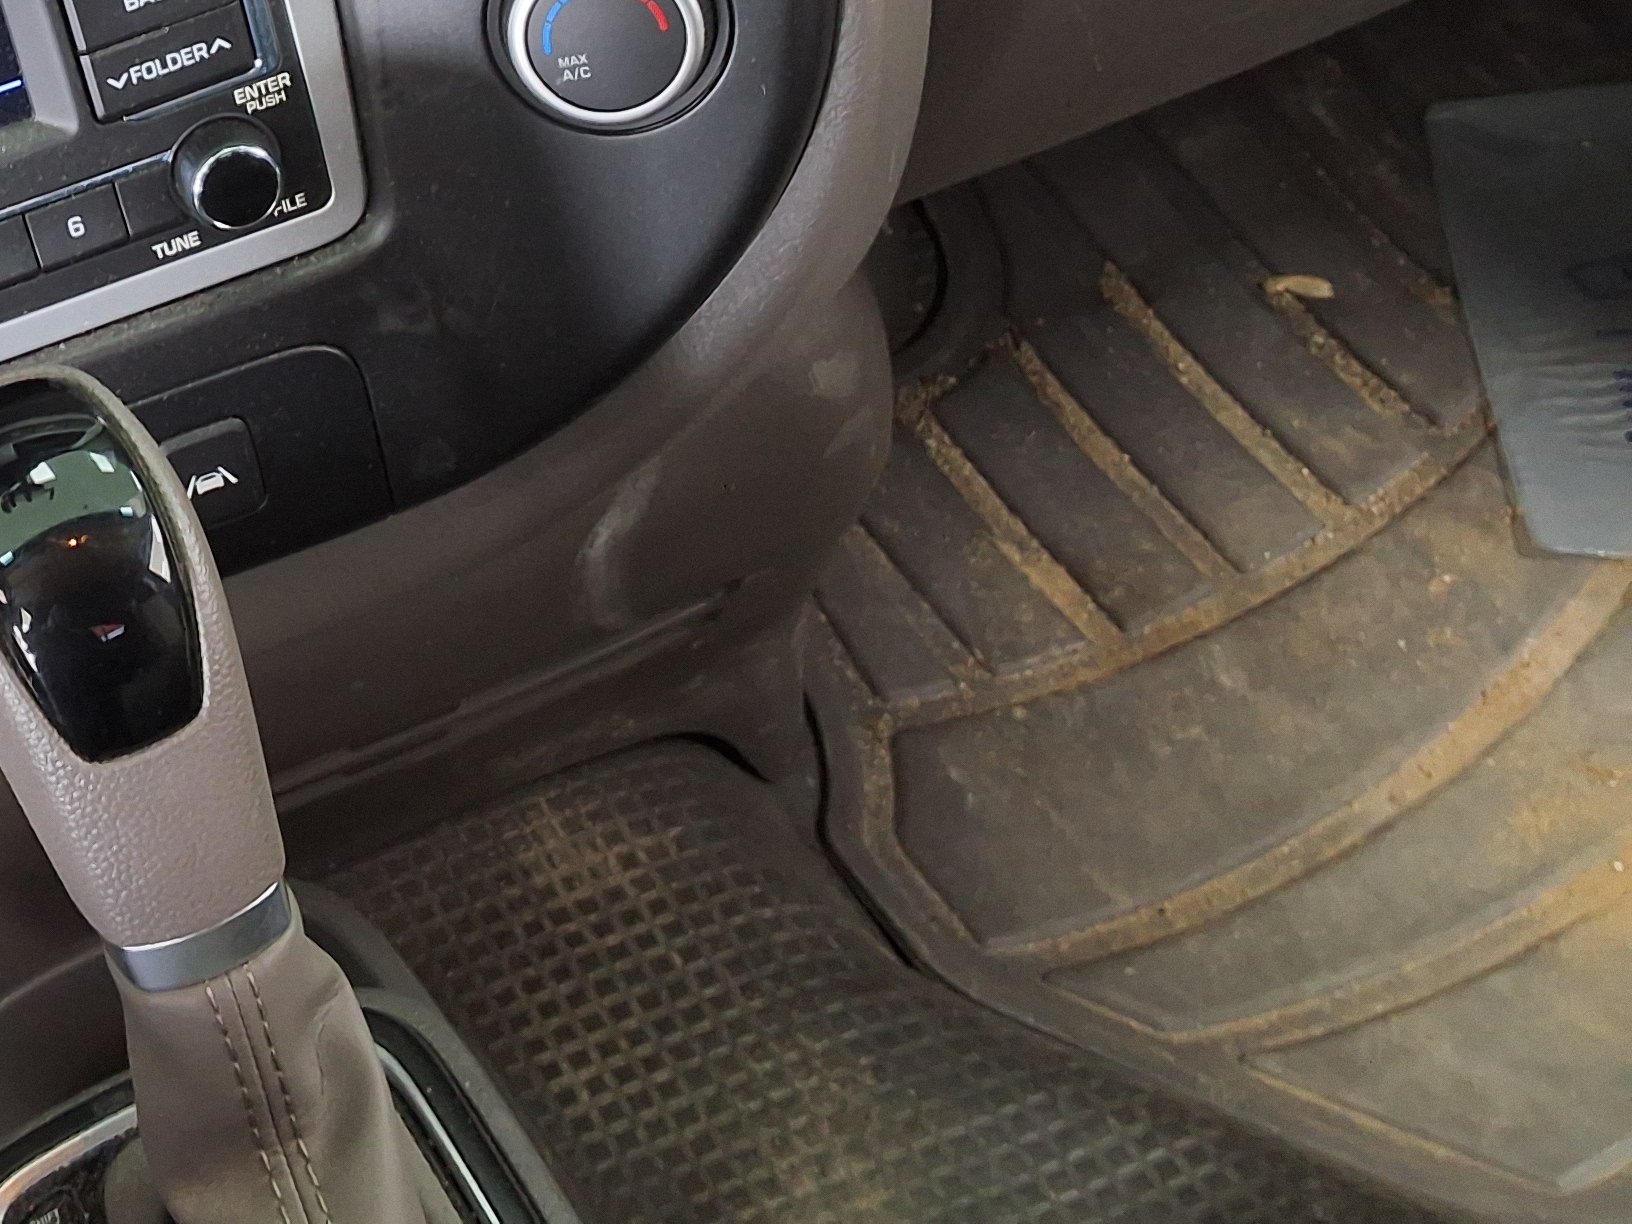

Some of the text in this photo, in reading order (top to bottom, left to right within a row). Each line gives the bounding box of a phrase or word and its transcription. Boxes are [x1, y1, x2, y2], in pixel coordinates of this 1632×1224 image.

[127, 43, 210, 87] FOLDER
[558, 53, 589, 69] MAX
[562, 66, 592, 82] A/C
[233, 71, 291, 105] ENTER
[246, 89, 286, 115] PUSH
[67, 215, 86, 239] 6
[151, 230, 202, 260] TUNE
